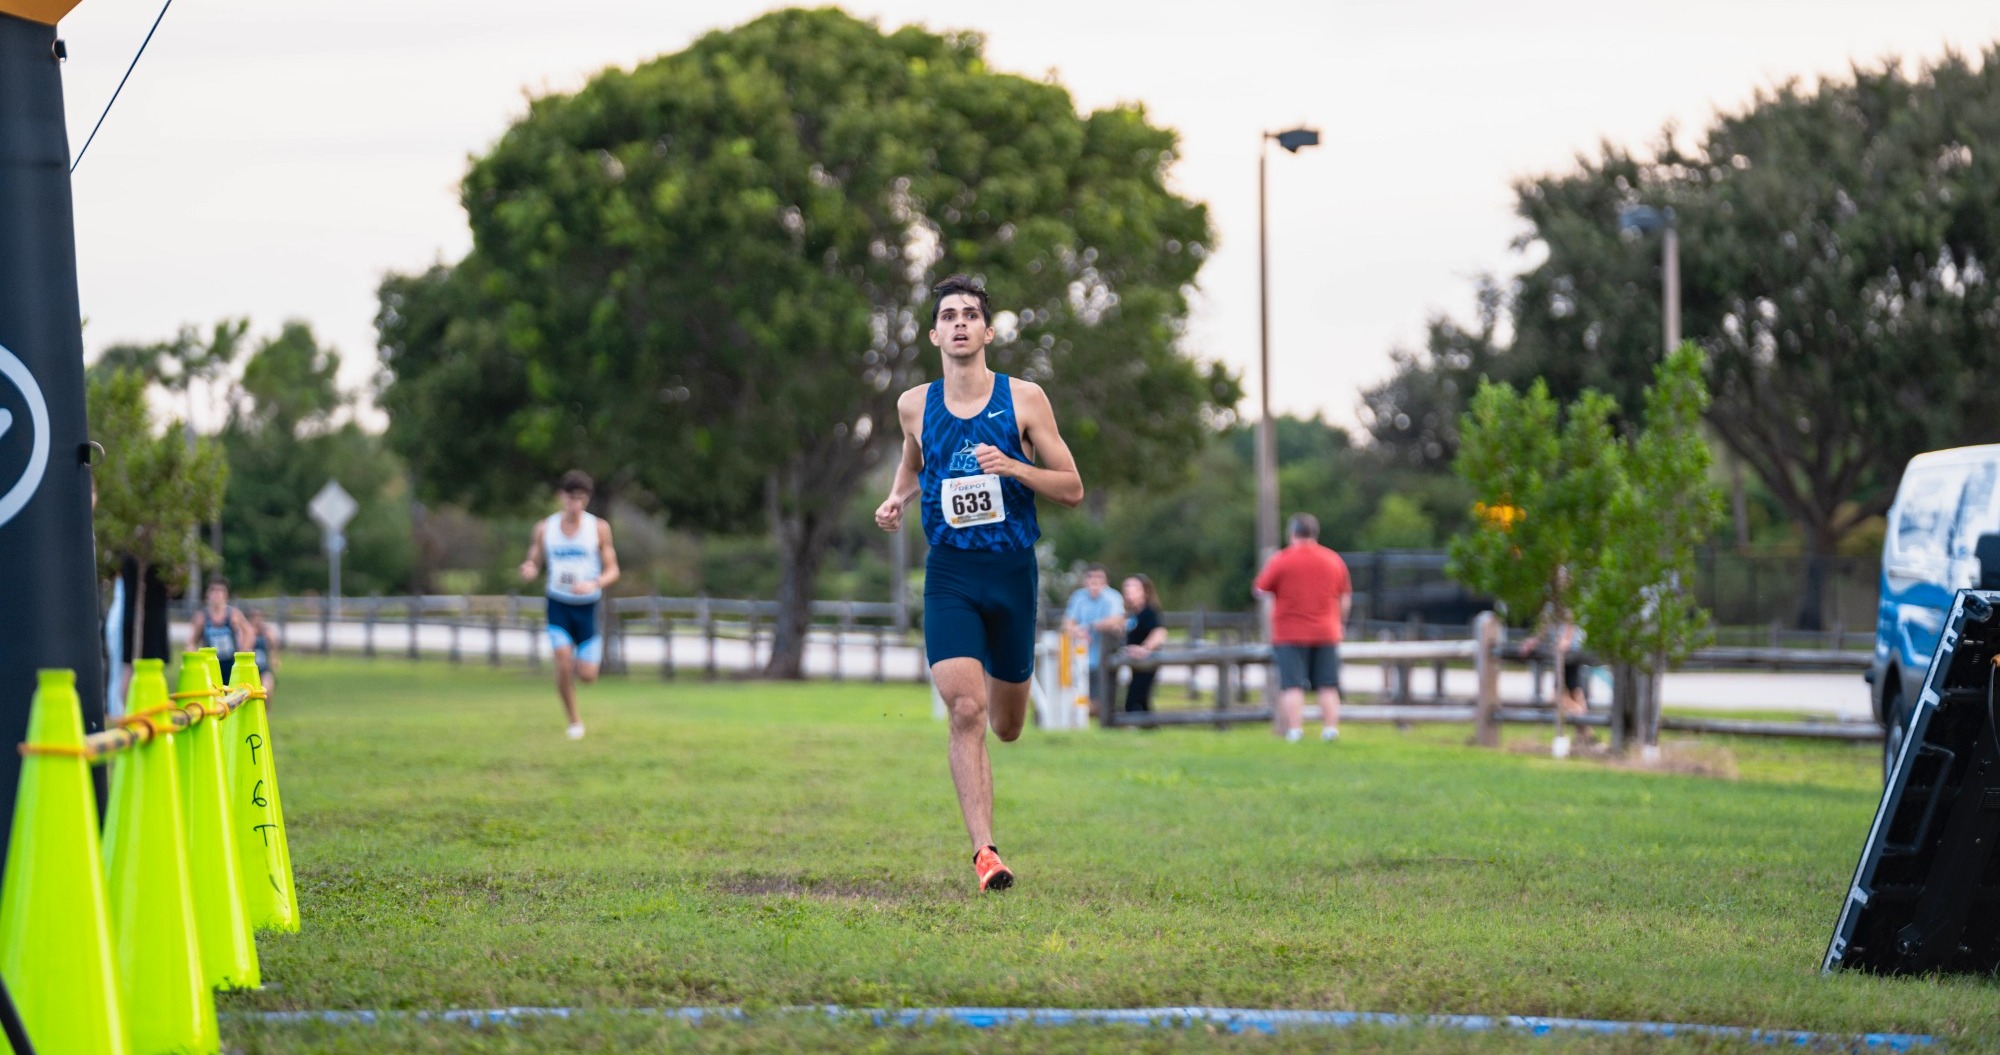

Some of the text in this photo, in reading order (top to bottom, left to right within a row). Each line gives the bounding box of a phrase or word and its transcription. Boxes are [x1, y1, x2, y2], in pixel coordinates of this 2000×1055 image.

[950, 452, 981, 472] NS
[958, 482, 986, 491] DEPOT
[952, 491, 992, 515] 633
